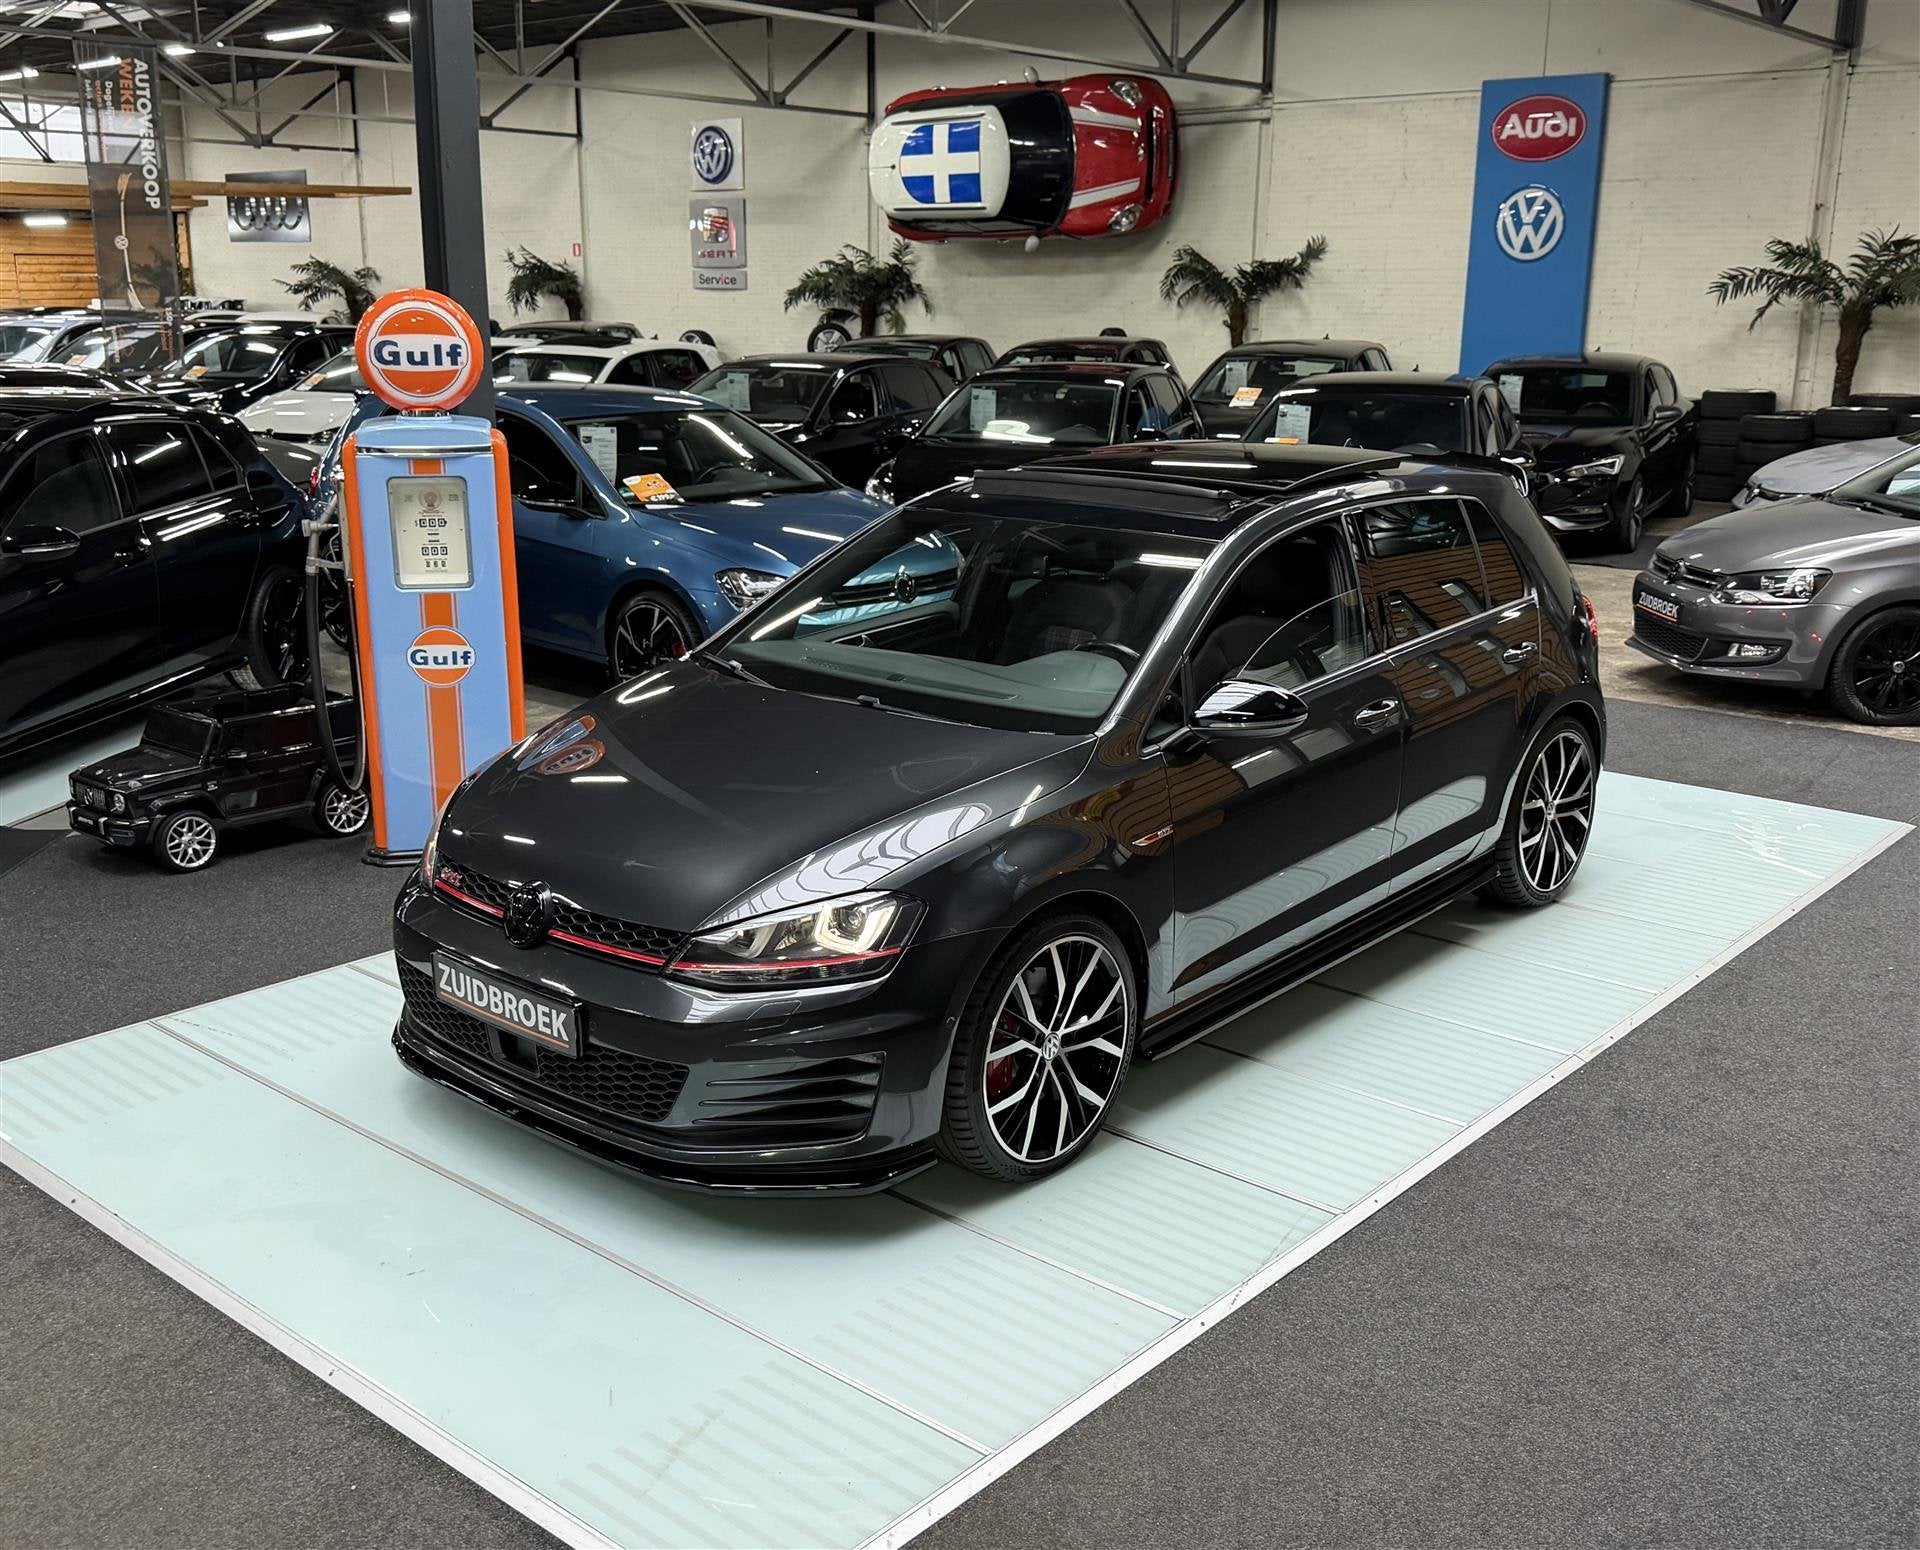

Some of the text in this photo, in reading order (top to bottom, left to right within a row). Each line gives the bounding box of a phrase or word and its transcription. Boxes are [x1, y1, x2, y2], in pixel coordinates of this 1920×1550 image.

[104, 80, 116, 131] Dagelijk
[133, 57, 161, 210] AUTOVERKOOP
[1499, 110, 1578, 140] Audi
[698, 249, 737, 259] SEAT
[698, 273, 738, 286] Service
[373, 339, 463, 367] Gulf
[1638, 591, 1680, 619] ZUIDBROEK
[410, 648, 472, 666] Gulf
[437, 962, 570, 1042] ZUIDBROEK
